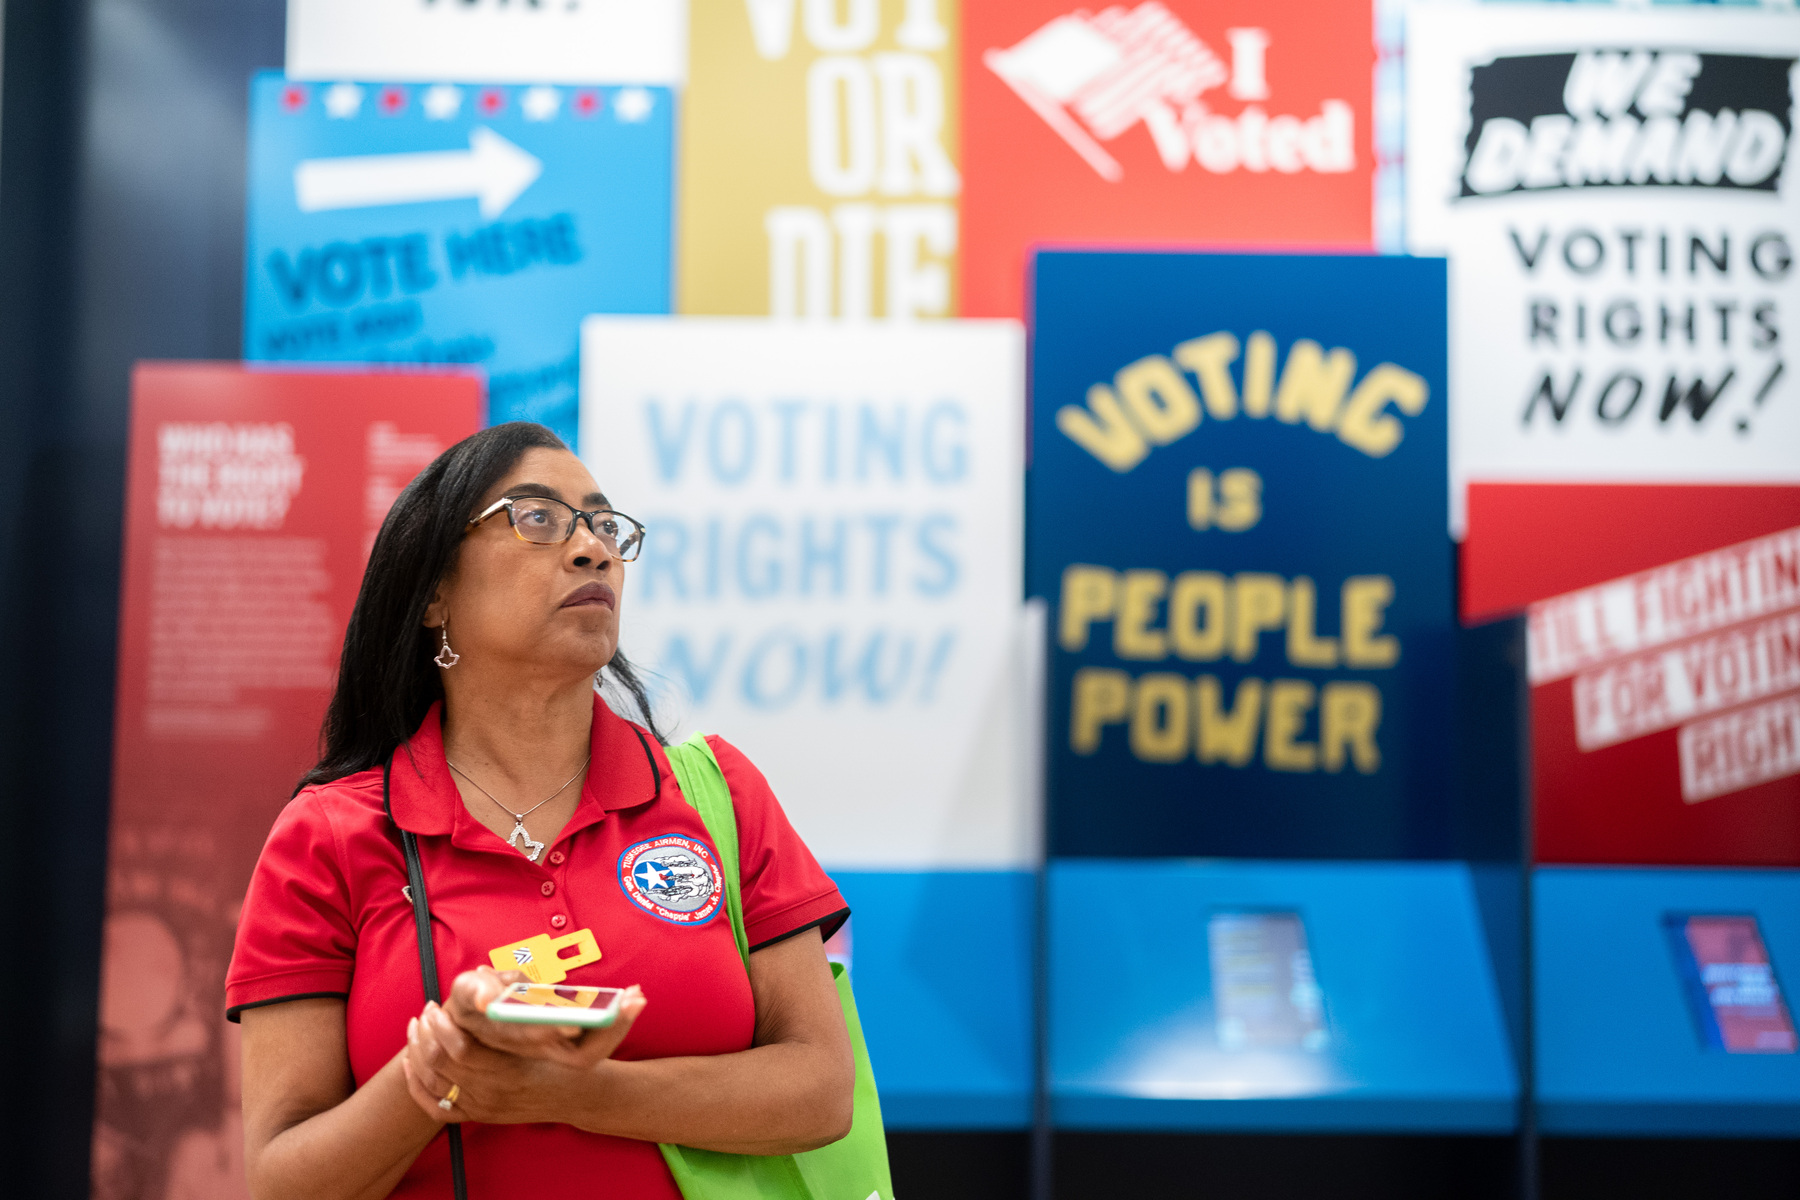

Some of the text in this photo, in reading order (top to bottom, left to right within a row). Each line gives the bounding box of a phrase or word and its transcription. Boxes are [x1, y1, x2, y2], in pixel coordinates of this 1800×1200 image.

[1226, 27, 1270, 102] I
[1563, 51, 1702, 118] WE
[806, 51, 962, 198] OR
[1143, 99, 1356, 173] Voted
[1466, 108, 1786, 195] DEMAND
[266, 212, 584, 309] VOTE HERE
[1509, 227, 1795, 281] VOTING
[1529, 302, 1780, 350] RIGHTS
[1056, 329, 1431, 473] VOTING
[1521, 362, 1785, 436] NOW!
[644, 397, 970, 486] VOTING
[1186, 466, 1263, 532] IS
[640, 512, 963, 604] RIGHTS
[1059, 563, 1400, 669] PEOPLE
[1070, 667, 1382, 774] POWER
[654, 837, 690, 849] AIRMEN,
